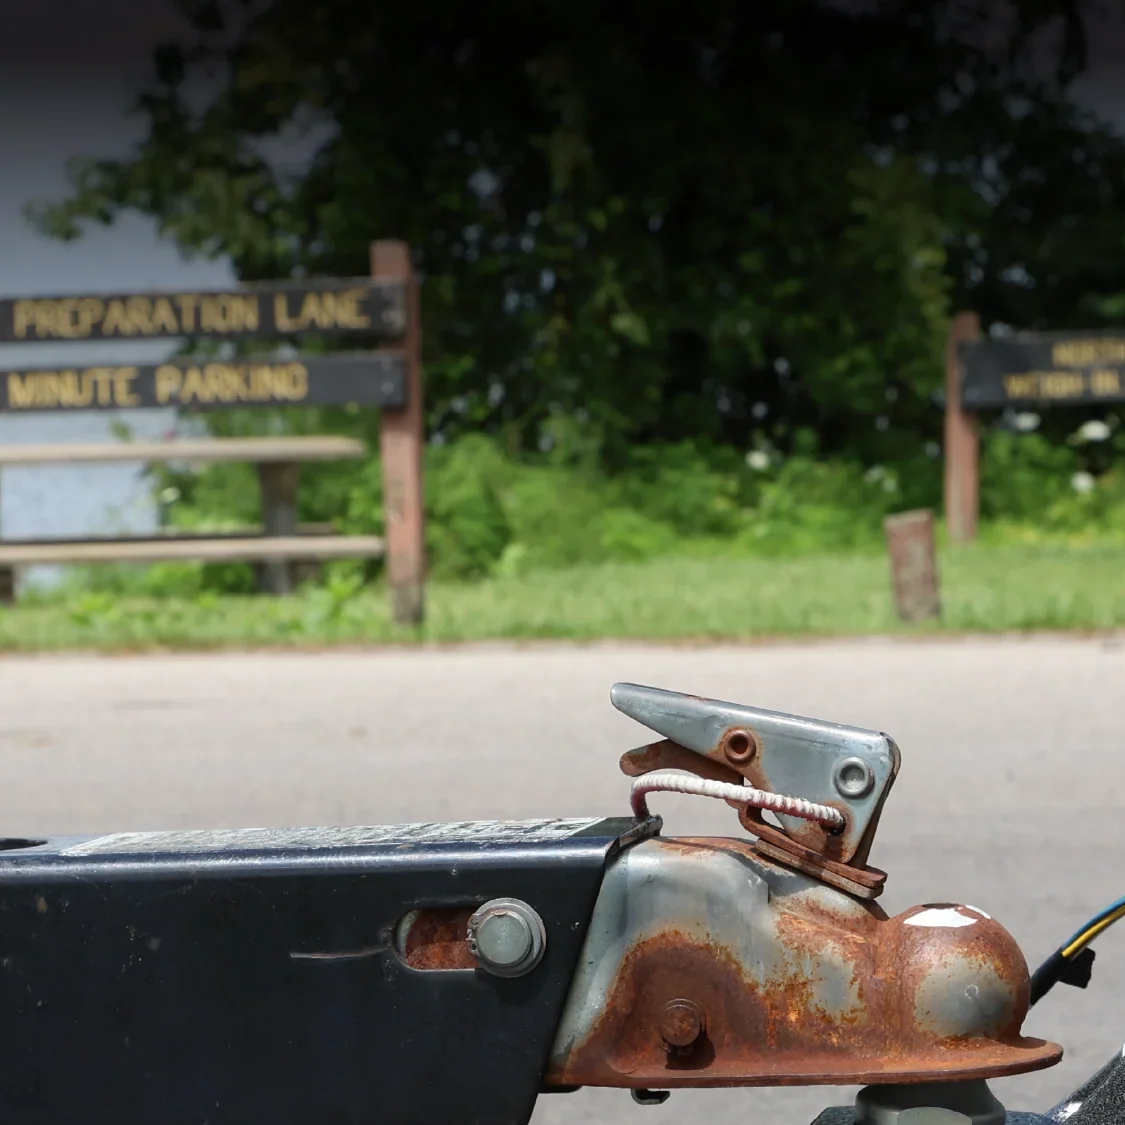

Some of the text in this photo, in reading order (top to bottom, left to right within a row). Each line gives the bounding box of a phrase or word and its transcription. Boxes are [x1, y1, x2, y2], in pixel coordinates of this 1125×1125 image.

[13, 287, 371, 338] PREPARATION LANE
[6, 361, 309, 409] MINUTE PARKING
